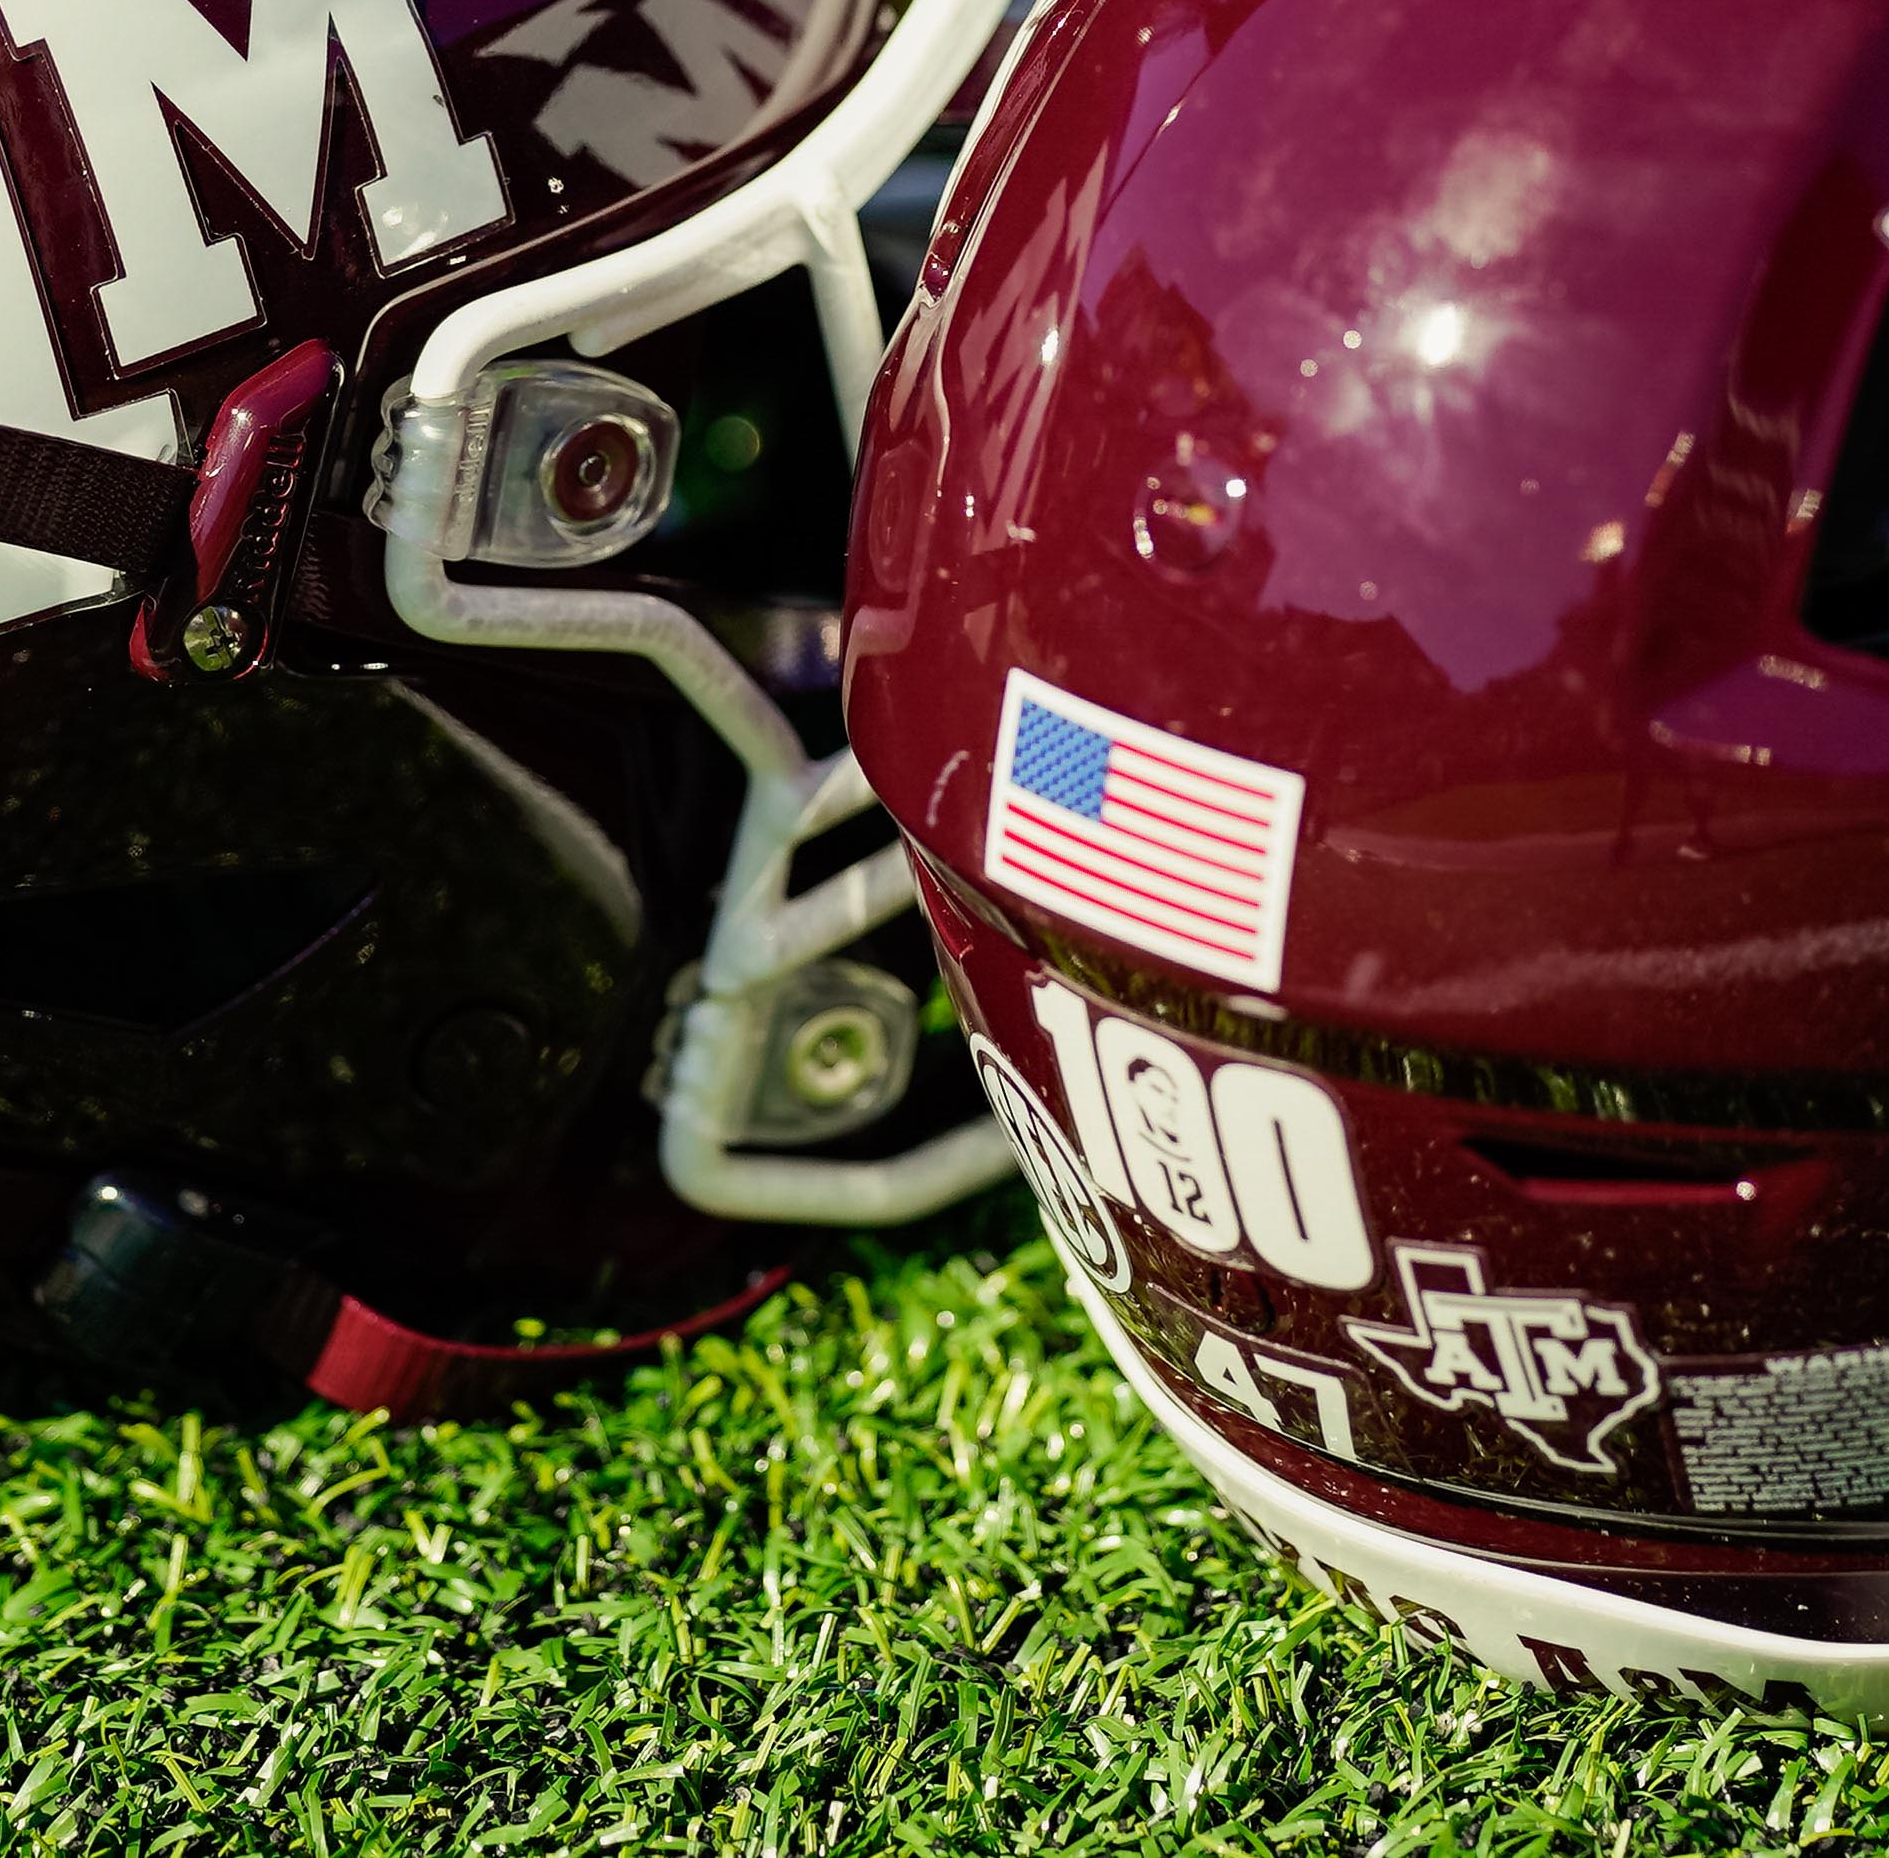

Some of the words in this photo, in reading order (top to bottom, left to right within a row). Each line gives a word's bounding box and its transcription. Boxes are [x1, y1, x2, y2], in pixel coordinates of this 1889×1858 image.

[1031, 979, 1374, 1290] 100
[1159, 1160, 1211, 1223] 12
[1193, 1330, 1358, 1461] 47
